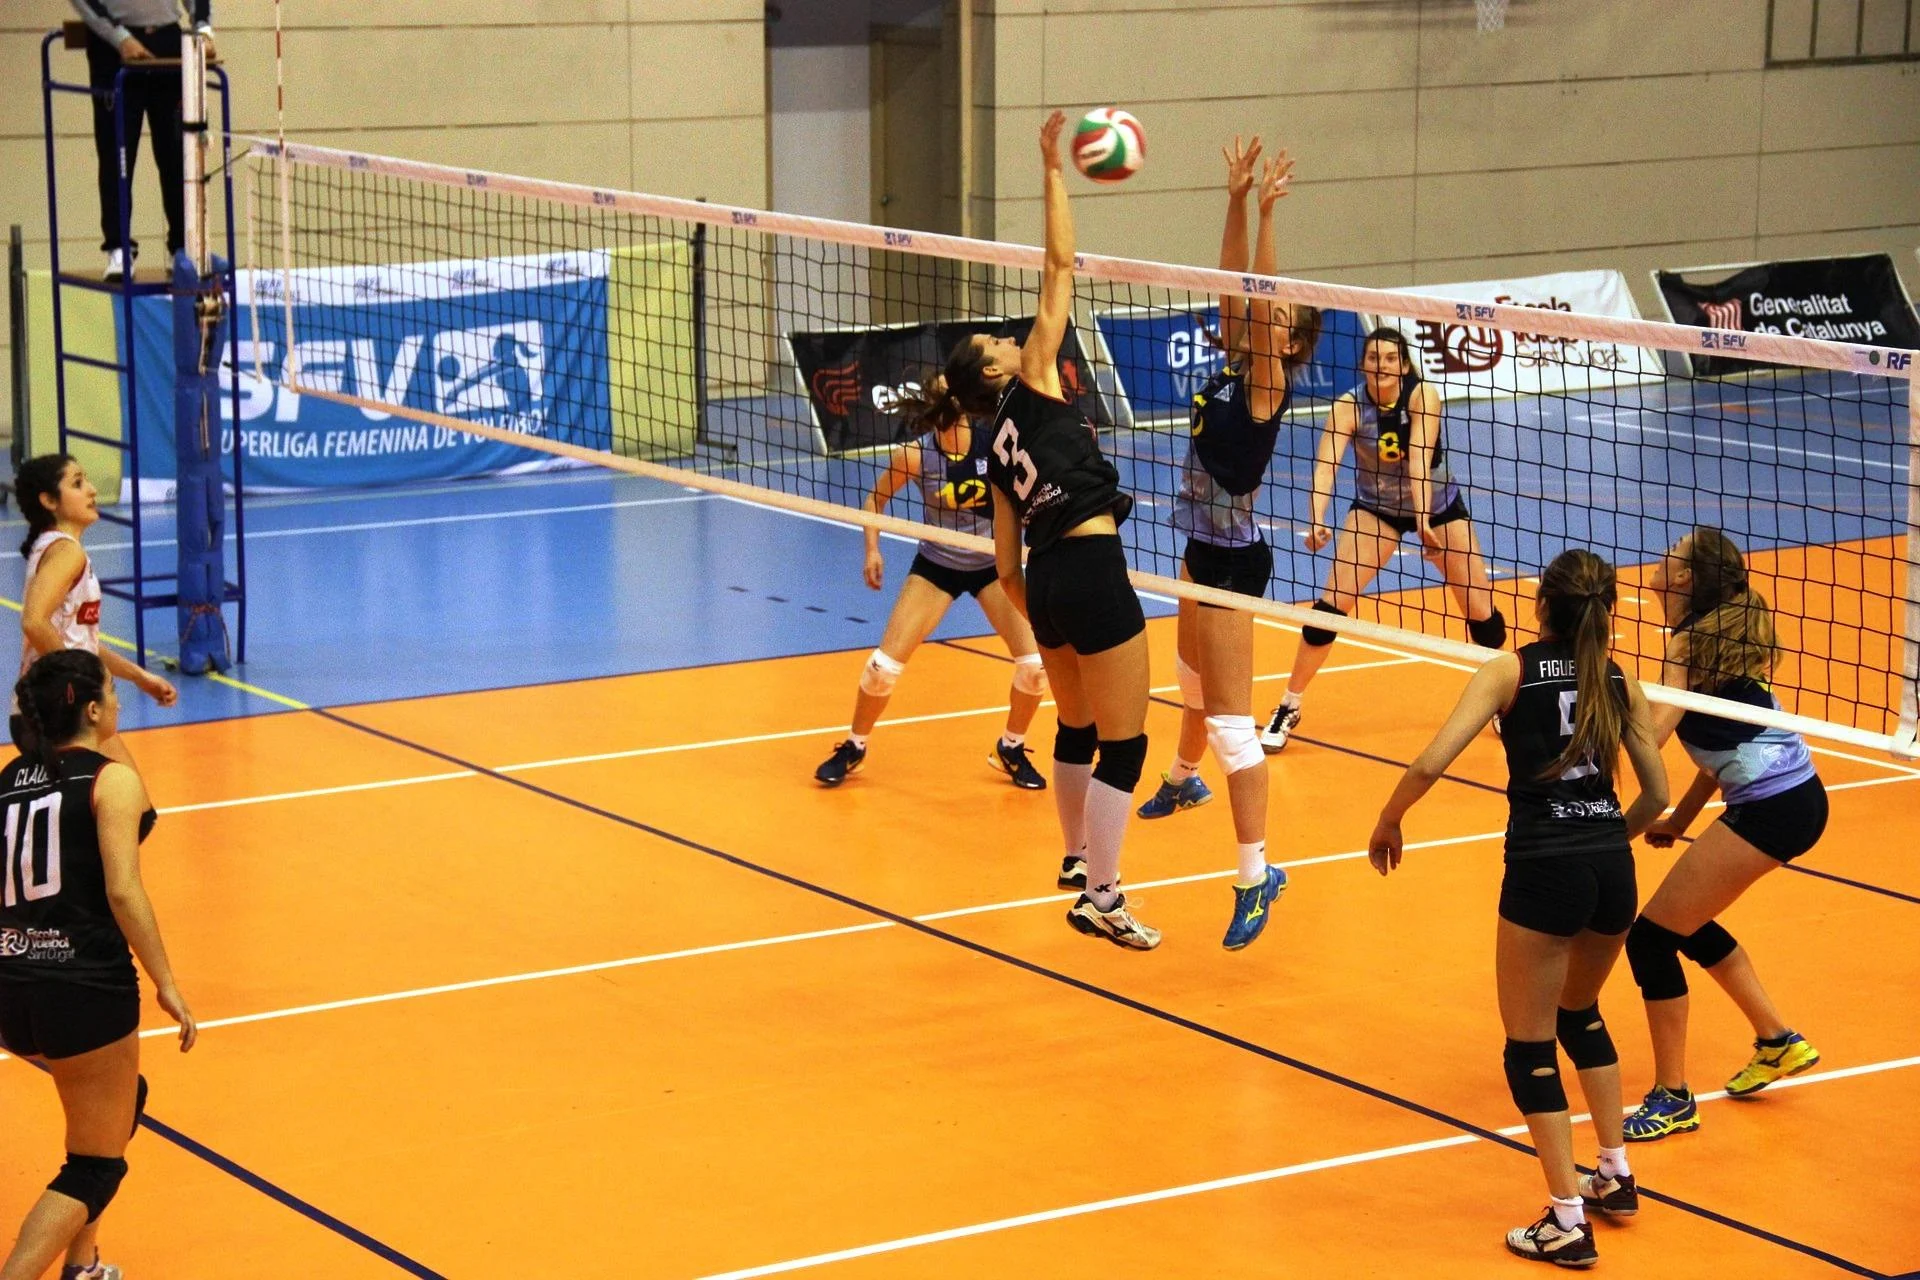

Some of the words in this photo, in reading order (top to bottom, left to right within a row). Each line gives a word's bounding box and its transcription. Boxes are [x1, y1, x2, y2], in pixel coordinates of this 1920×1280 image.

[1259, 279, 1276, 291] SFV
[1475, 306, 1495, 318] SFV
[1750, 292, 1853, 316] Generalitat
[1723, 334, 1746, 347] SFV
[218, 335, 424, 422] SFV
[323, 424, 428, 458] FEMENINA
[433, 424, 456, 449] DE
[1378, 431, 1401, 462] 8
[993, 417, 1037, 500] 3
[935, 478, 988, 510] 12
[4, 791, 62, 907] 10
